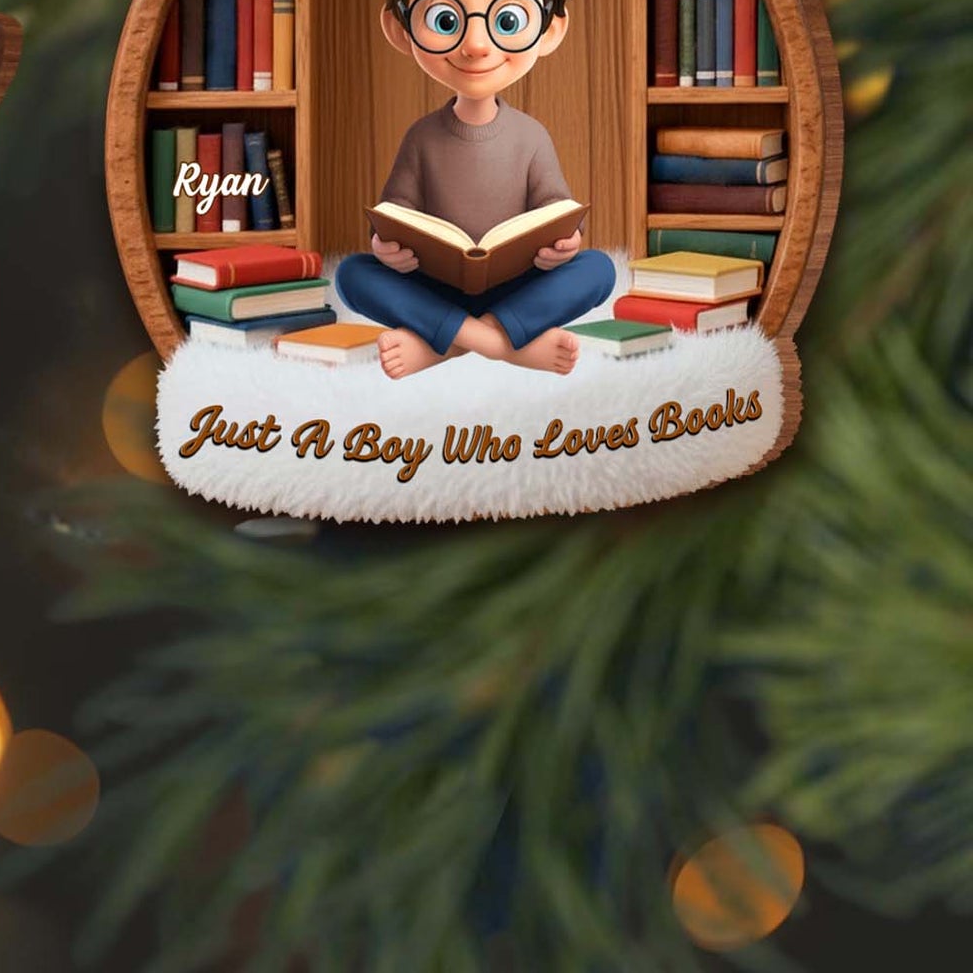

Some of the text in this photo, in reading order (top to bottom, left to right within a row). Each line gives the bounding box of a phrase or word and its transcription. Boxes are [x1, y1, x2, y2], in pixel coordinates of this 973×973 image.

[173, 161, 269, 214] Ryan
[179, 389, 763, 482] Just A Boy Who Loves Books
